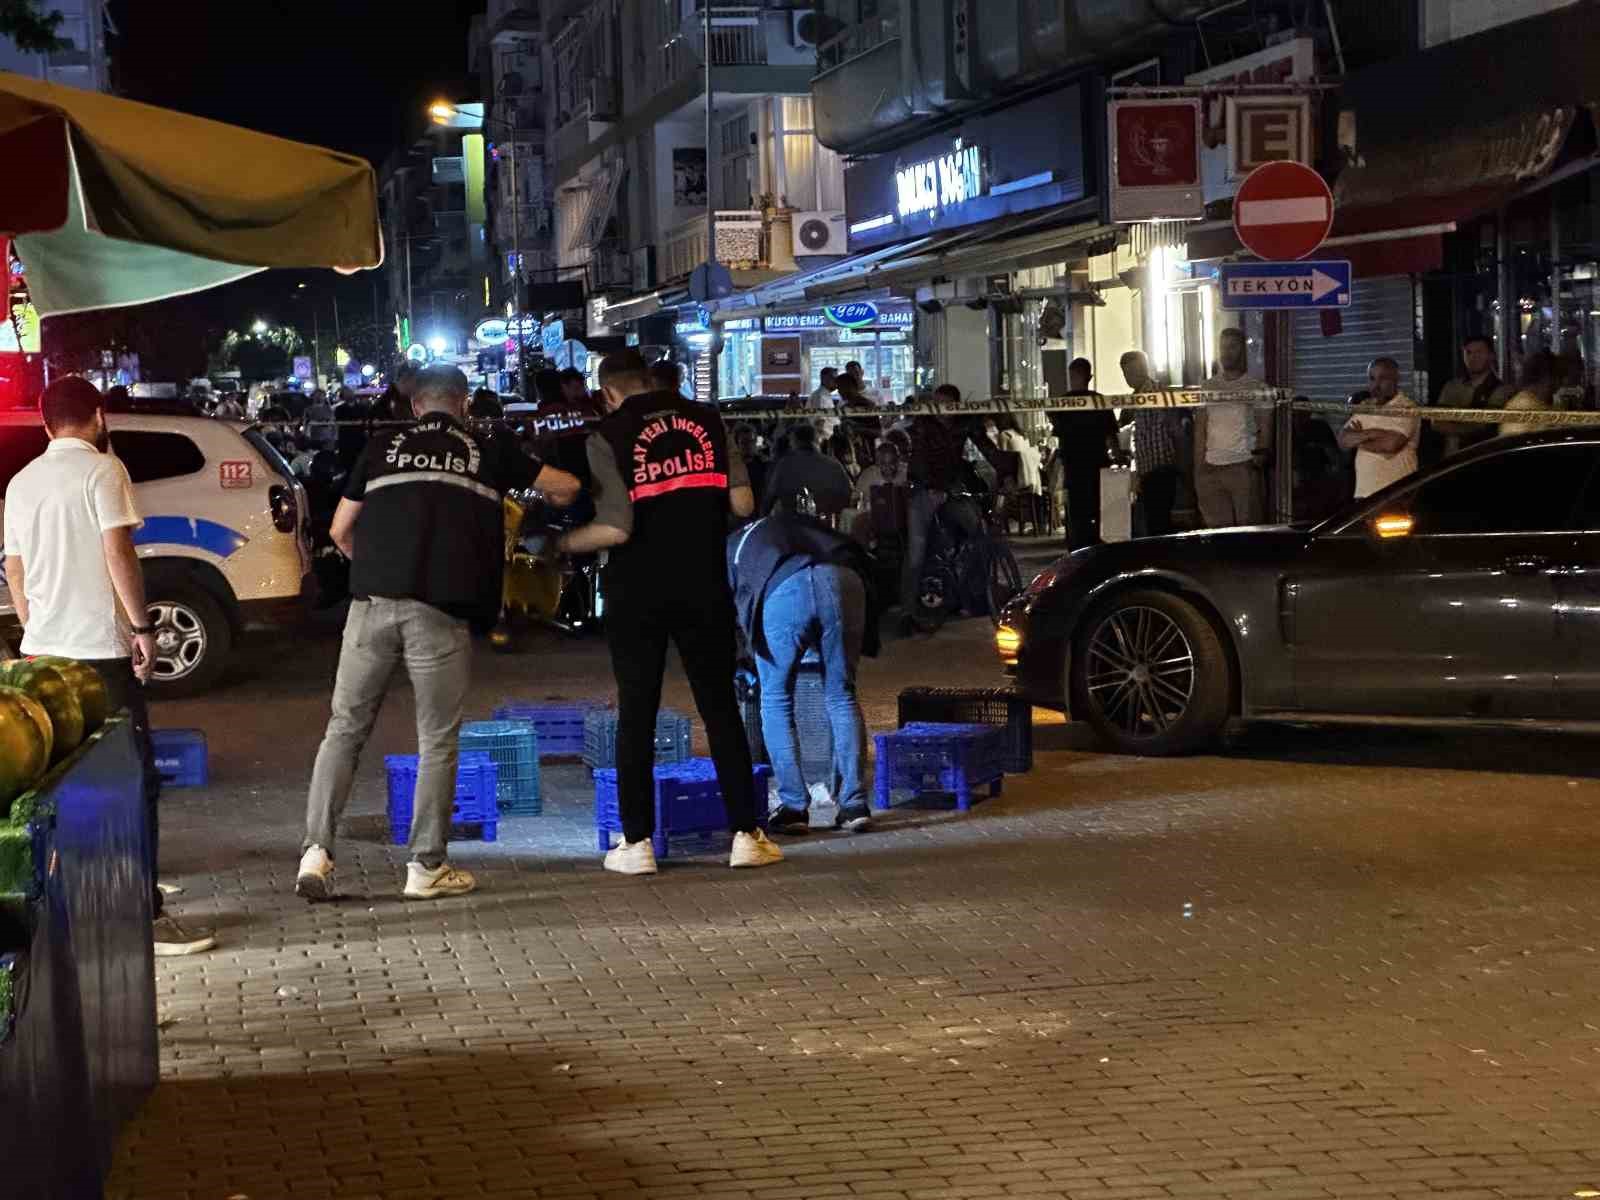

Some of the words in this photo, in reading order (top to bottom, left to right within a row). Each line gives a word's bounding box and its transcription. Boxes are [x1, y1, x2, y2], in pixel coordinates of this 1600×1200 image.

[1230, 279, 1266, 292] TEK
[222, 463, 250, 479] 112
[397, 451, 466, 474] POLİS
[633, 443, 648, 483] OLAY
[647, 448, 705, 481] POLİS
